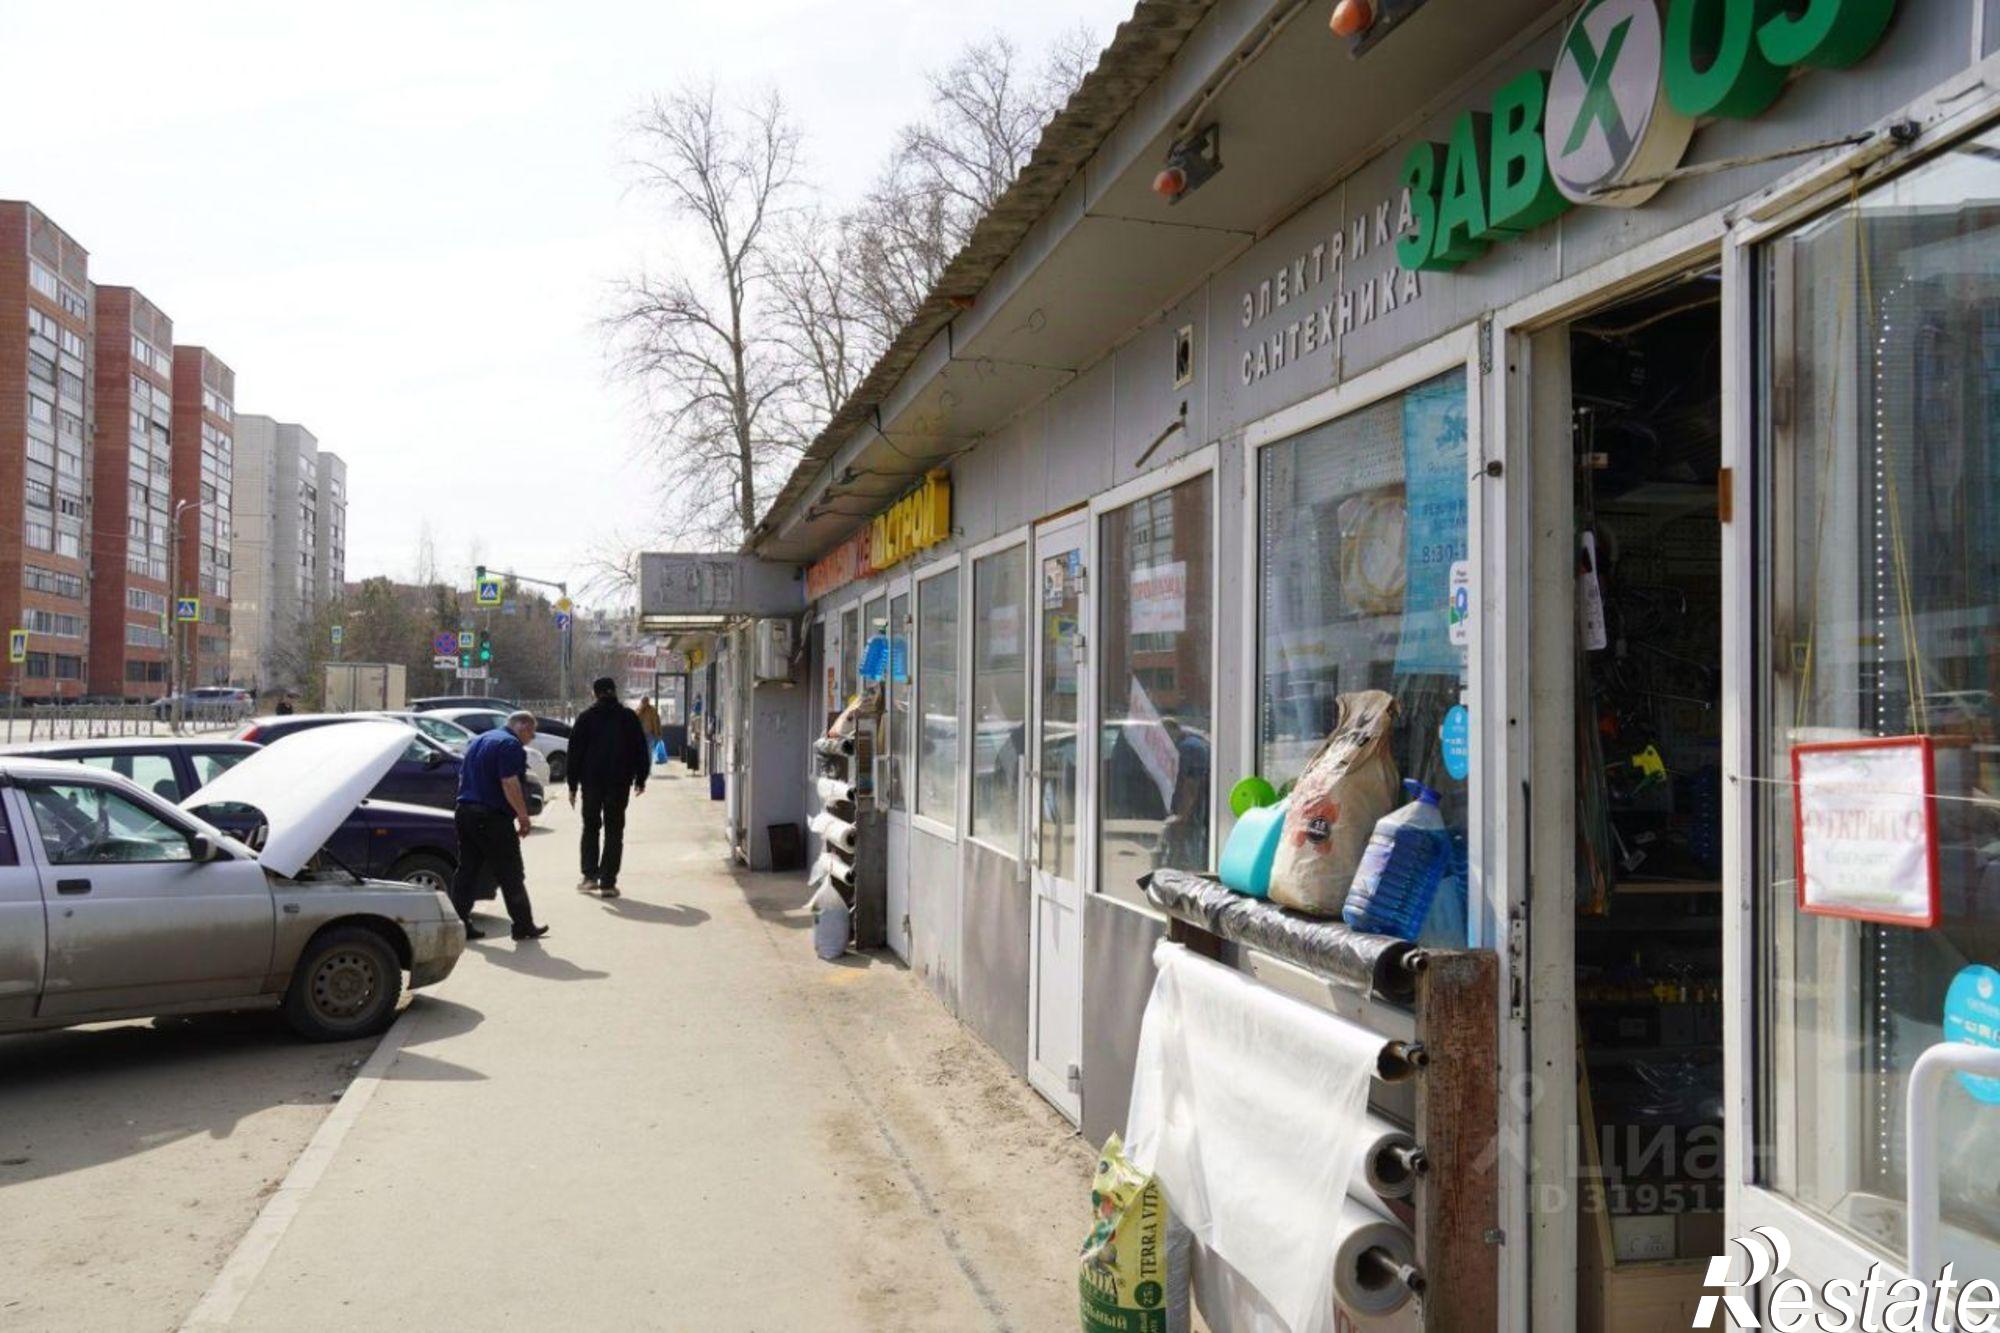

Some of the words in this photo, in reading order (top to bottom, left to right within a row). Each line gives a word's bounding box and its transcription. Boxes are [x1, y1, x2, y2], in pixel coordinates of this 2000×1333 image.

[1242, 187, 1420, 329] ЭЛЕКТРИКА
[1242, 267, 1421, 386] САНТЕХНИКА
[1140, 1222, 1158, 1279] TERRA
